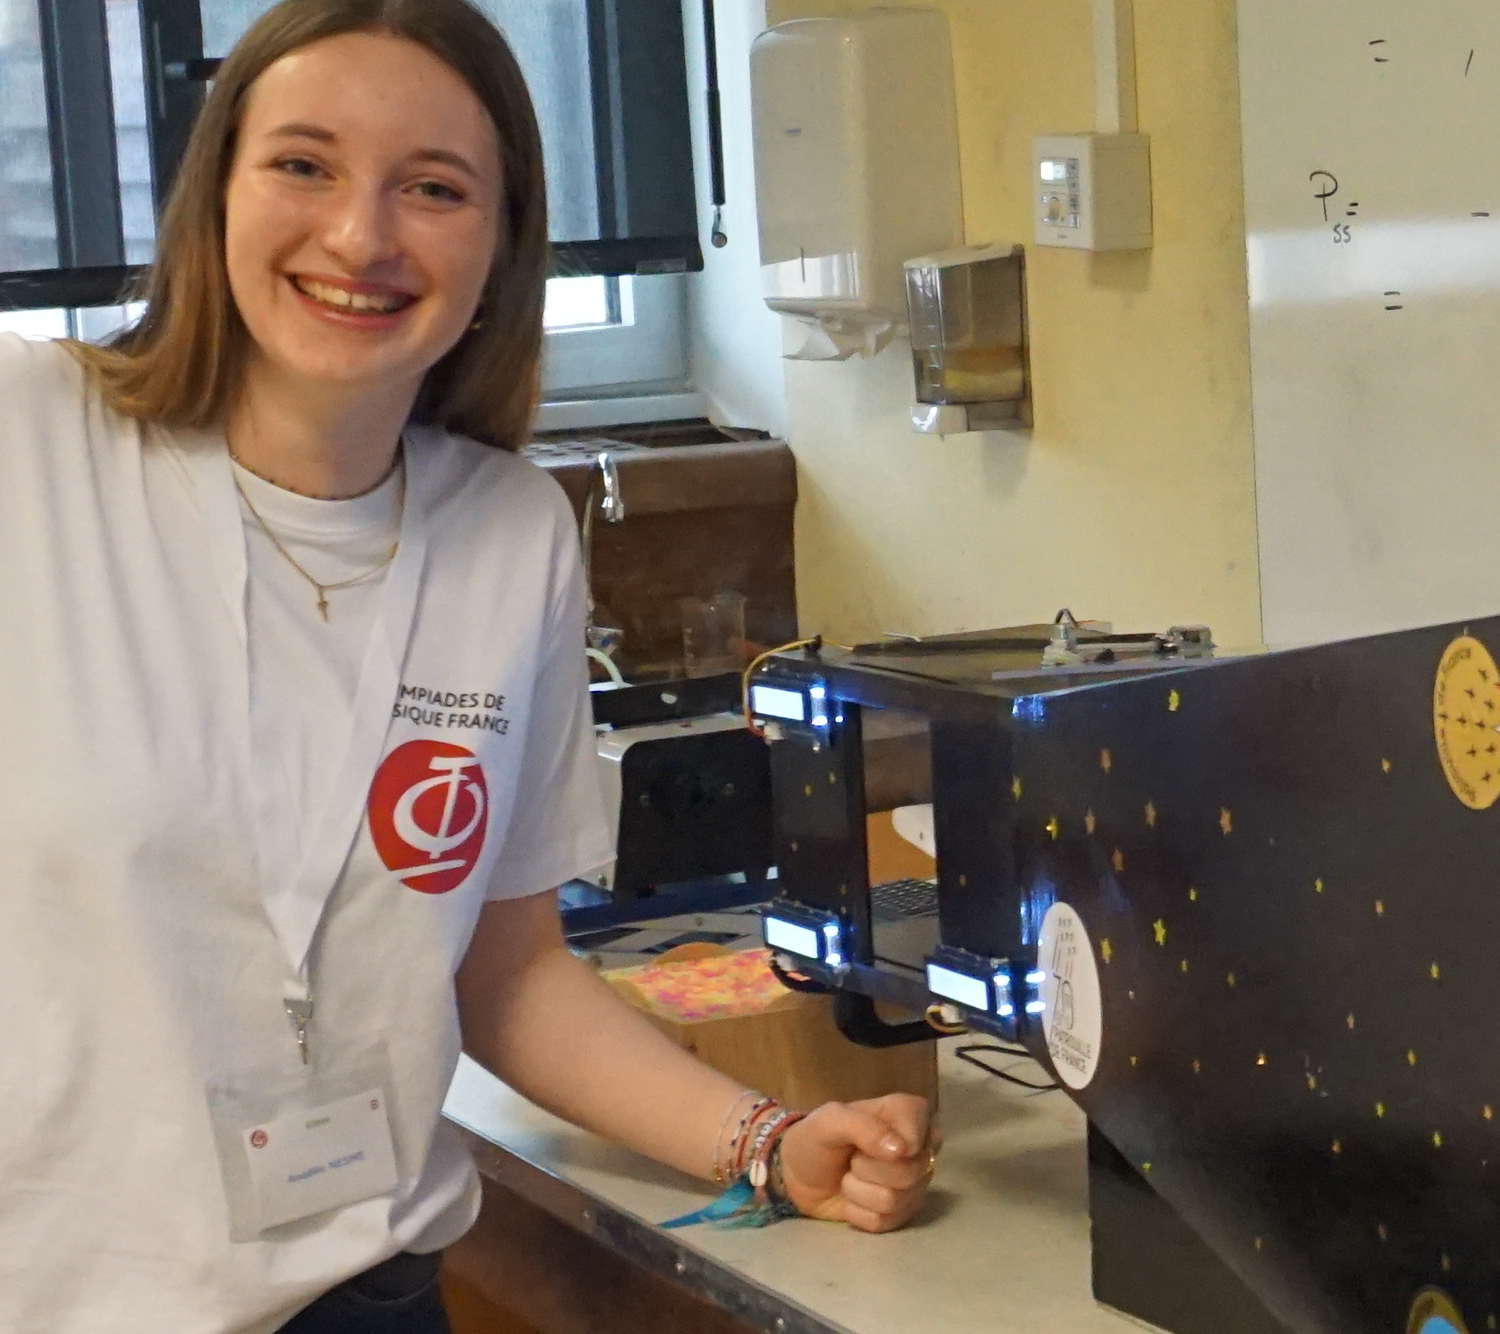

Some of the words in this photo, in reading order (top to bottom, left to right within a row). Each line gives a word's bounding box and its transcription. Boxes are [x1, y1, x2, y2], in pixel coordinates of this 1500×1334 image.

[399, 684, 479, 709] MPIADES
[484, 694, 506, 711] DE
[392, 703, 444, 727] SIQUE
